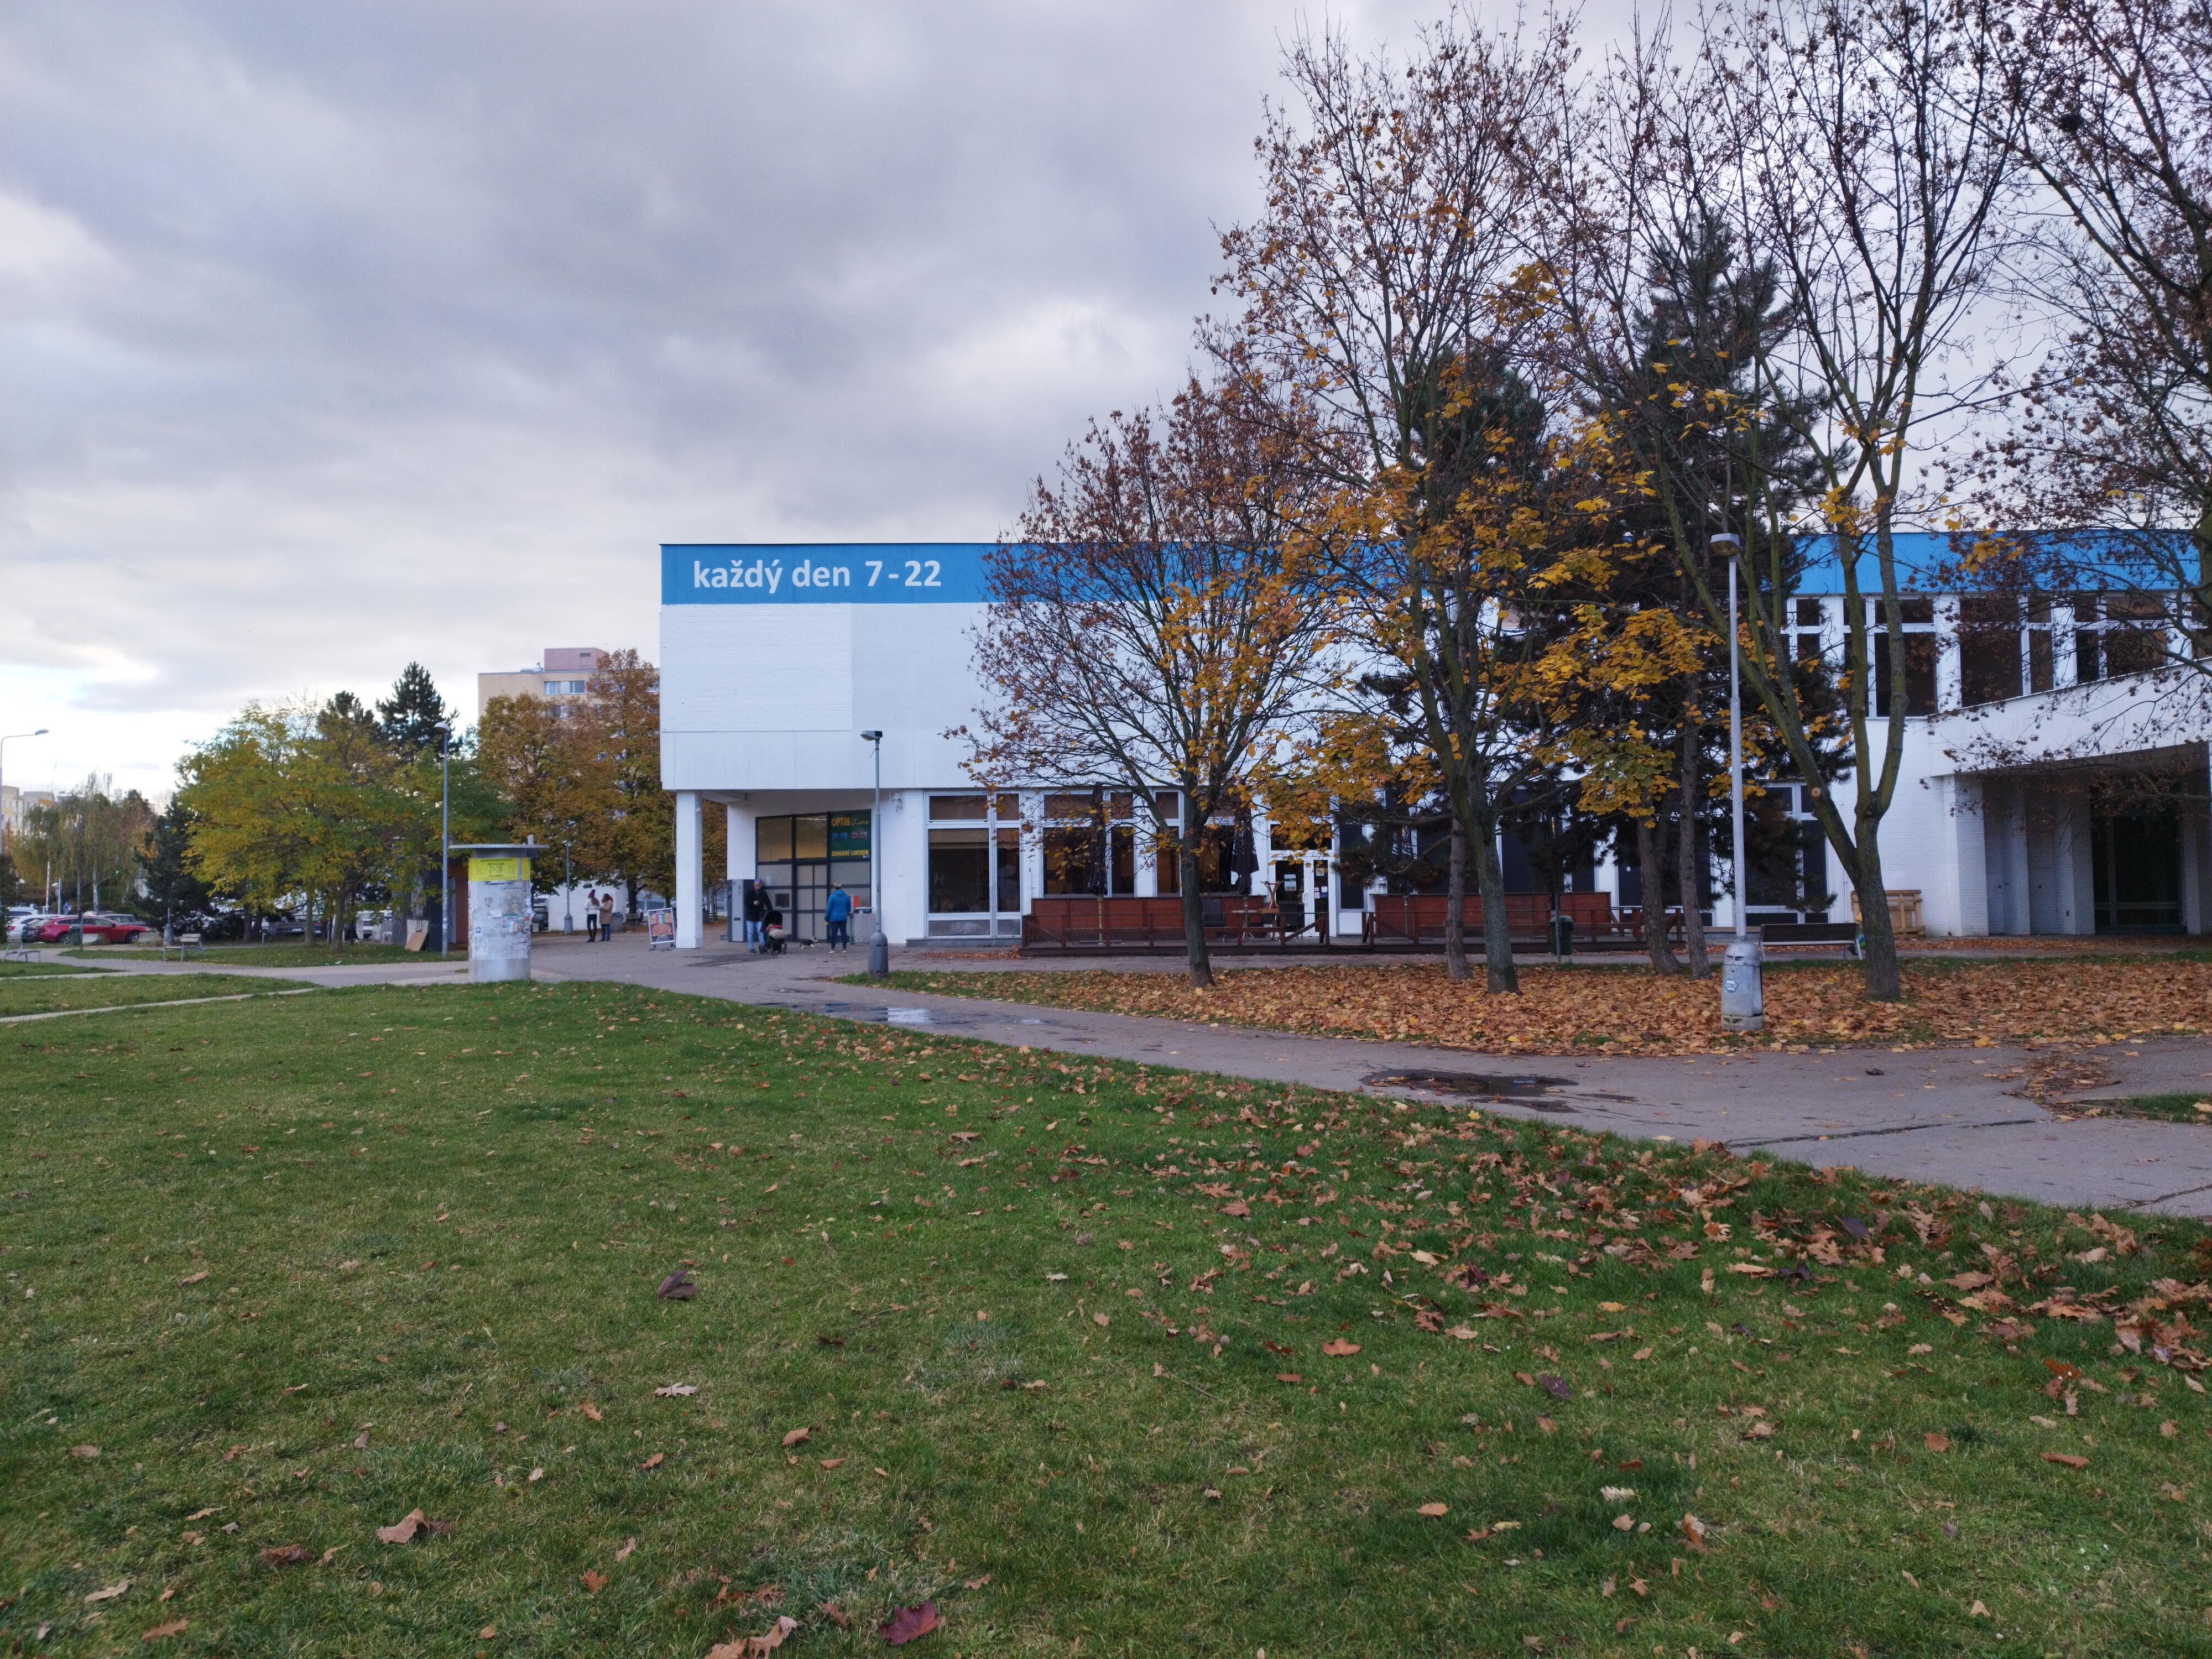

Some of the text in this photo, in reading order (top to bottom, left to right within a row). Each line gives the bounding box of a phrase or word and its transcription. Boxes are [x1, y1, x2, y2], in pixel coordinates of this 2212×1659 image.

[694, 559, 783, 594] každý
[792, 559, 850, 587] den
[832, 817, 849, 826] OPTIK
